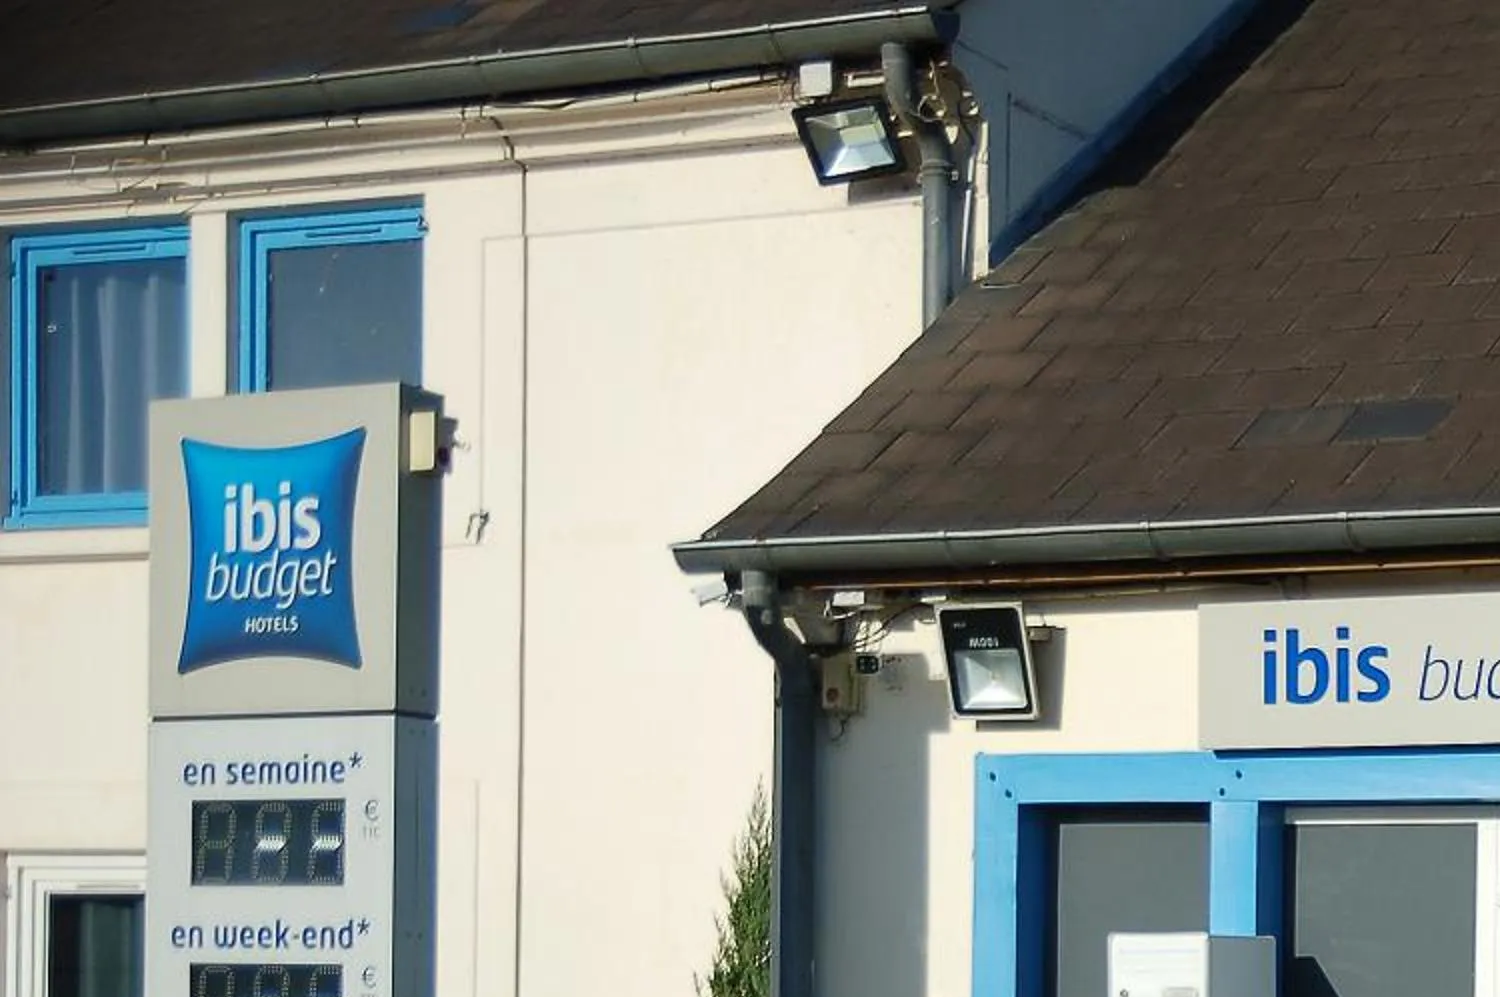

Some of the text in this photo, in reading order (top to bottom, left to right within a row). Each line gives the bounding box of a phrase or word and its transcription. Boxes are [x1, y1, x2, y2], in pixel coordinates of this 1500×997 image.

[224, 480, 322, 554] ibis
[205, 548, 337, 609] budget
[245, 615, 299, 634] HOTELS
[1264, 626, 1391, 705] ibis
[183, 762, 215, 785] en
[171, 925, 203, 948] en
